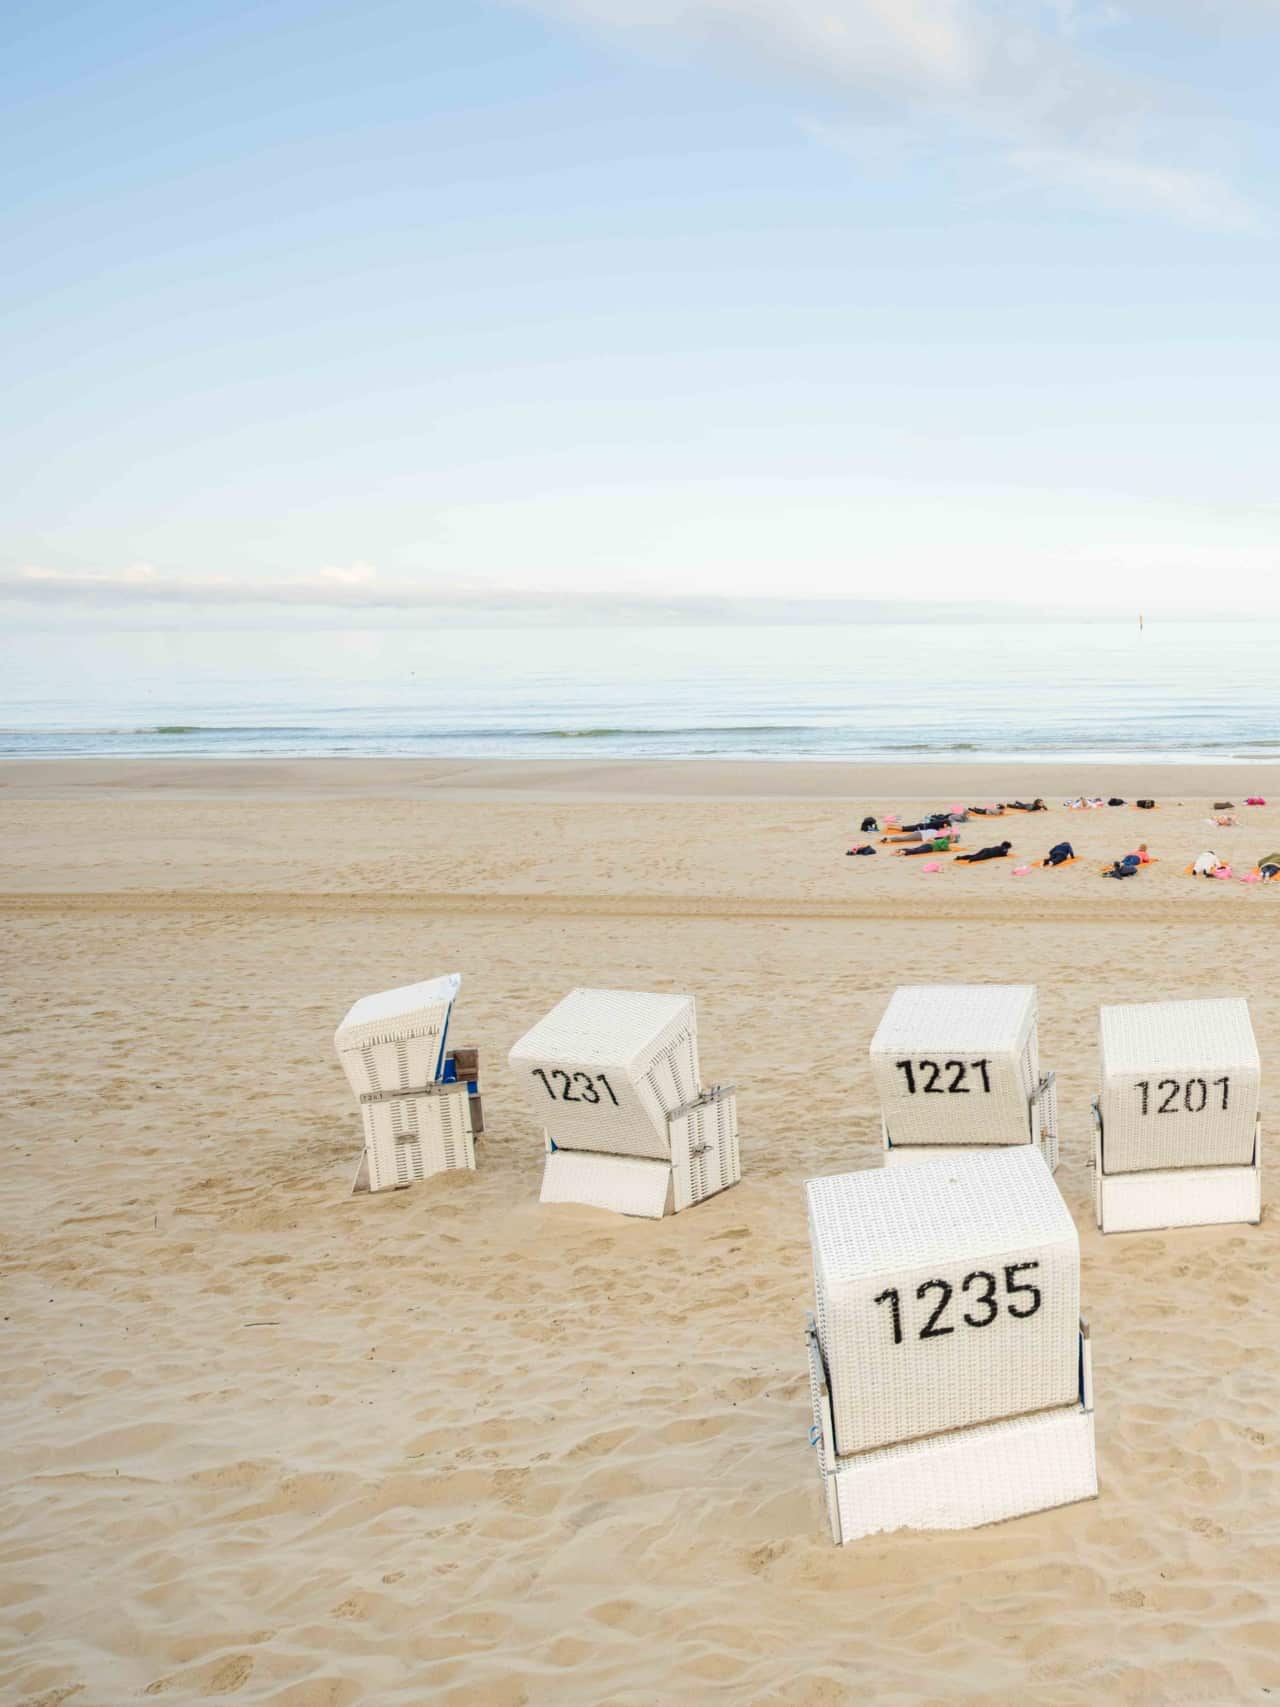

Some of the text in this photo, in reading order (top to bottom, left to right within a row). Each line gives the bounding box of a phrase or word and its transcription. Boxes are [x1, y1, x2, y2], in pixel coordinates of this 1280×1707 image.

[532, 1069, 619, 1106] 1231
[896, 1059, 991, 1094] 1221
[1136, 1077, 1229, 1115] 1201
[874, 1262, 1041, 1344] 1235
